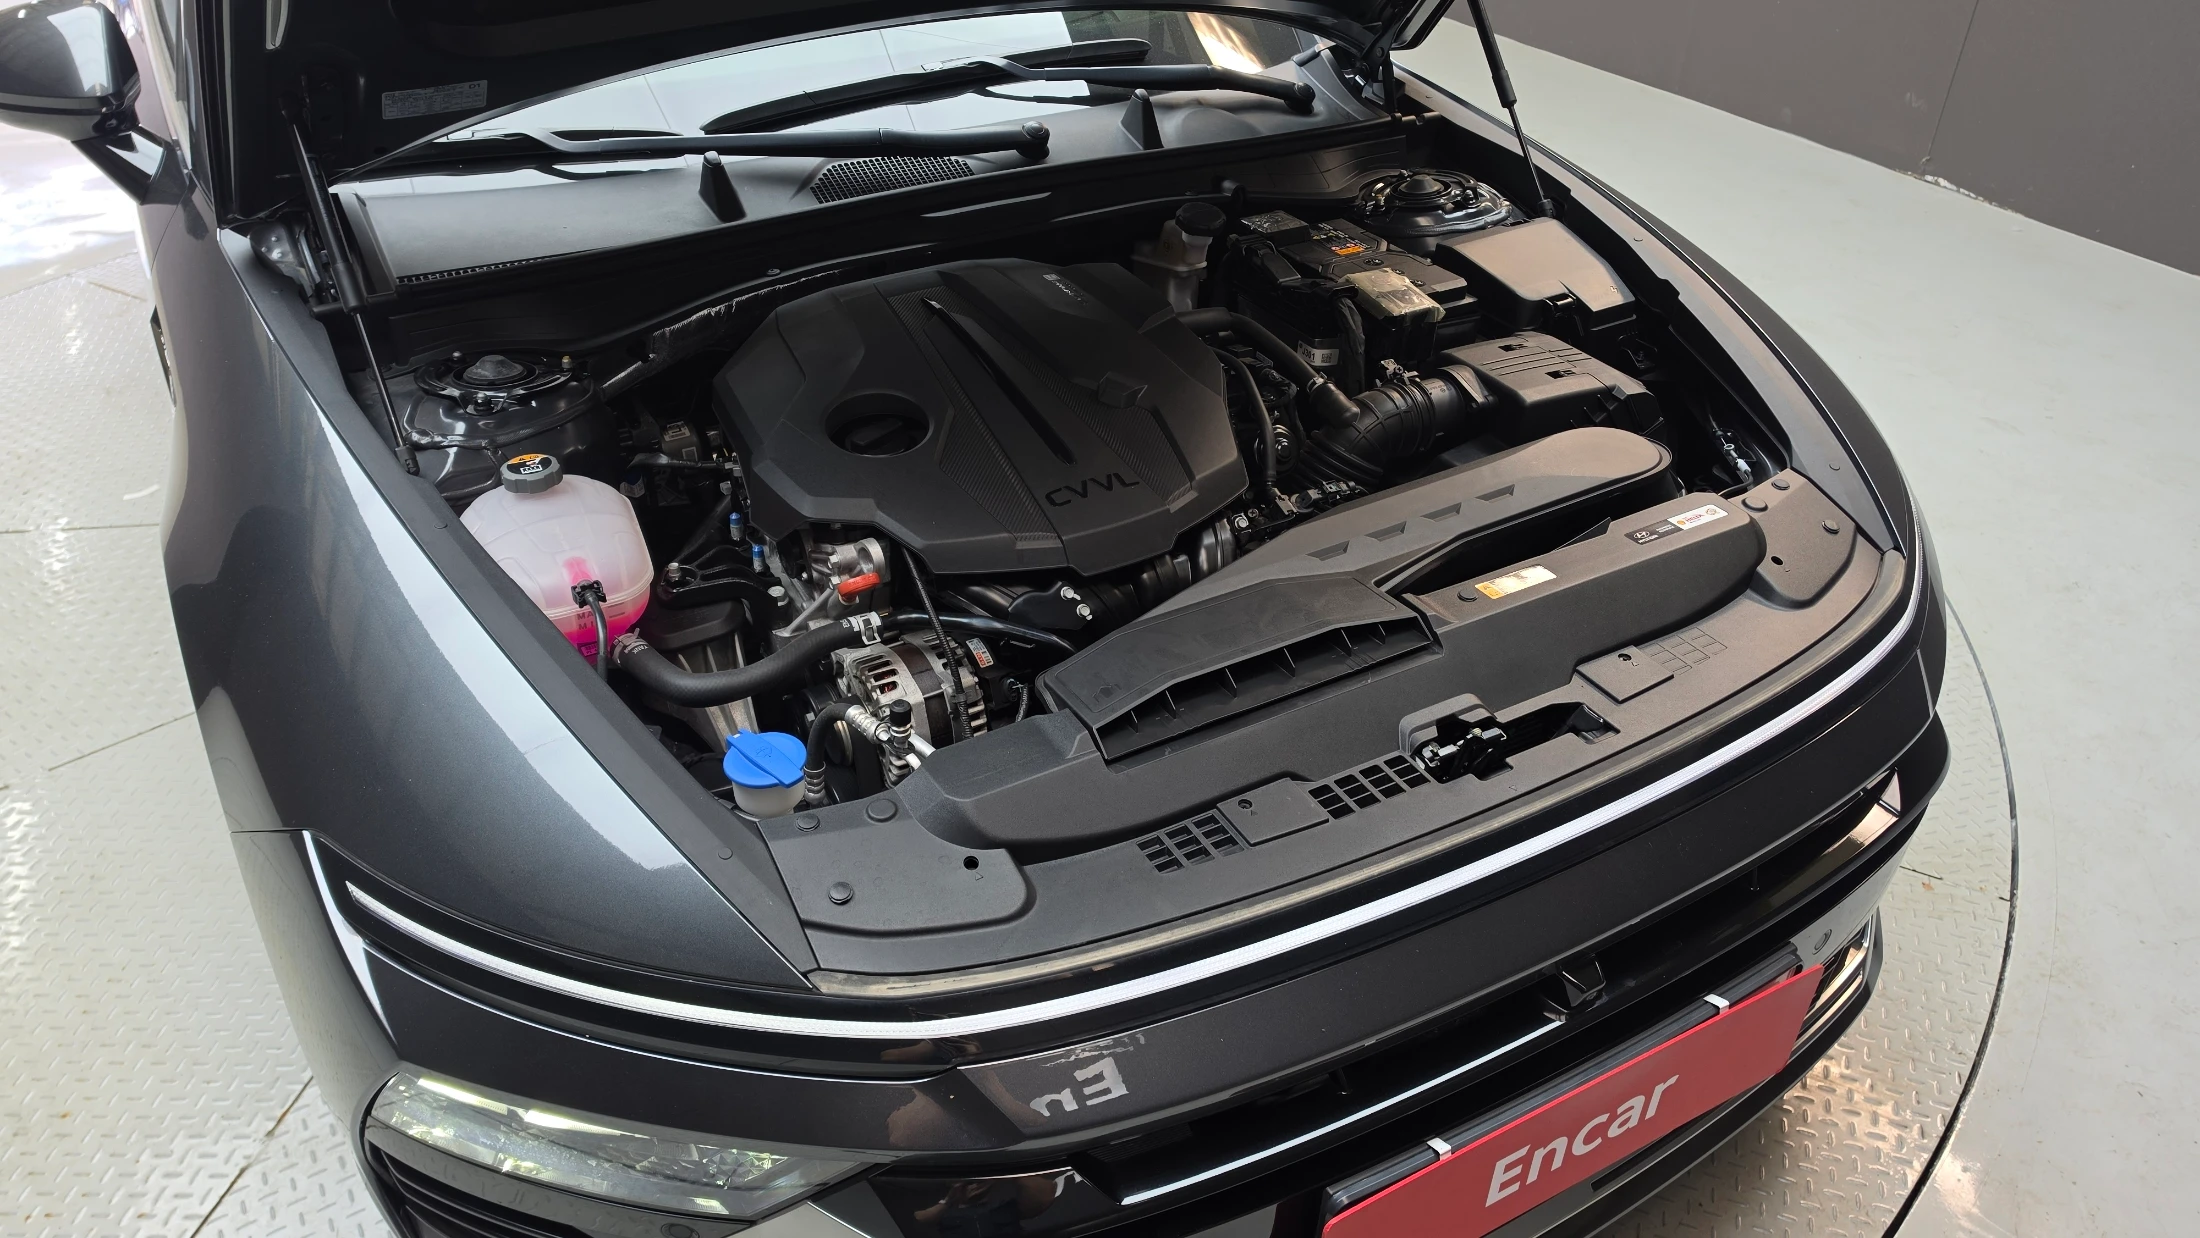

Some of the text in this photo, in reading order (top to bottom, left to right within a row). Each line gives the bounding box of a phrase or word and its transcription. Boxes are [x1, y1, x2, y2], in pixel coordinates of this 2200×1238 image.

[1301, 348, 1316, 361] J301
[1044, 472, 1140, 508] CVVL
[576, 610, 596, 621] MA
[1485, 1074, 1680, 1208] Encar
